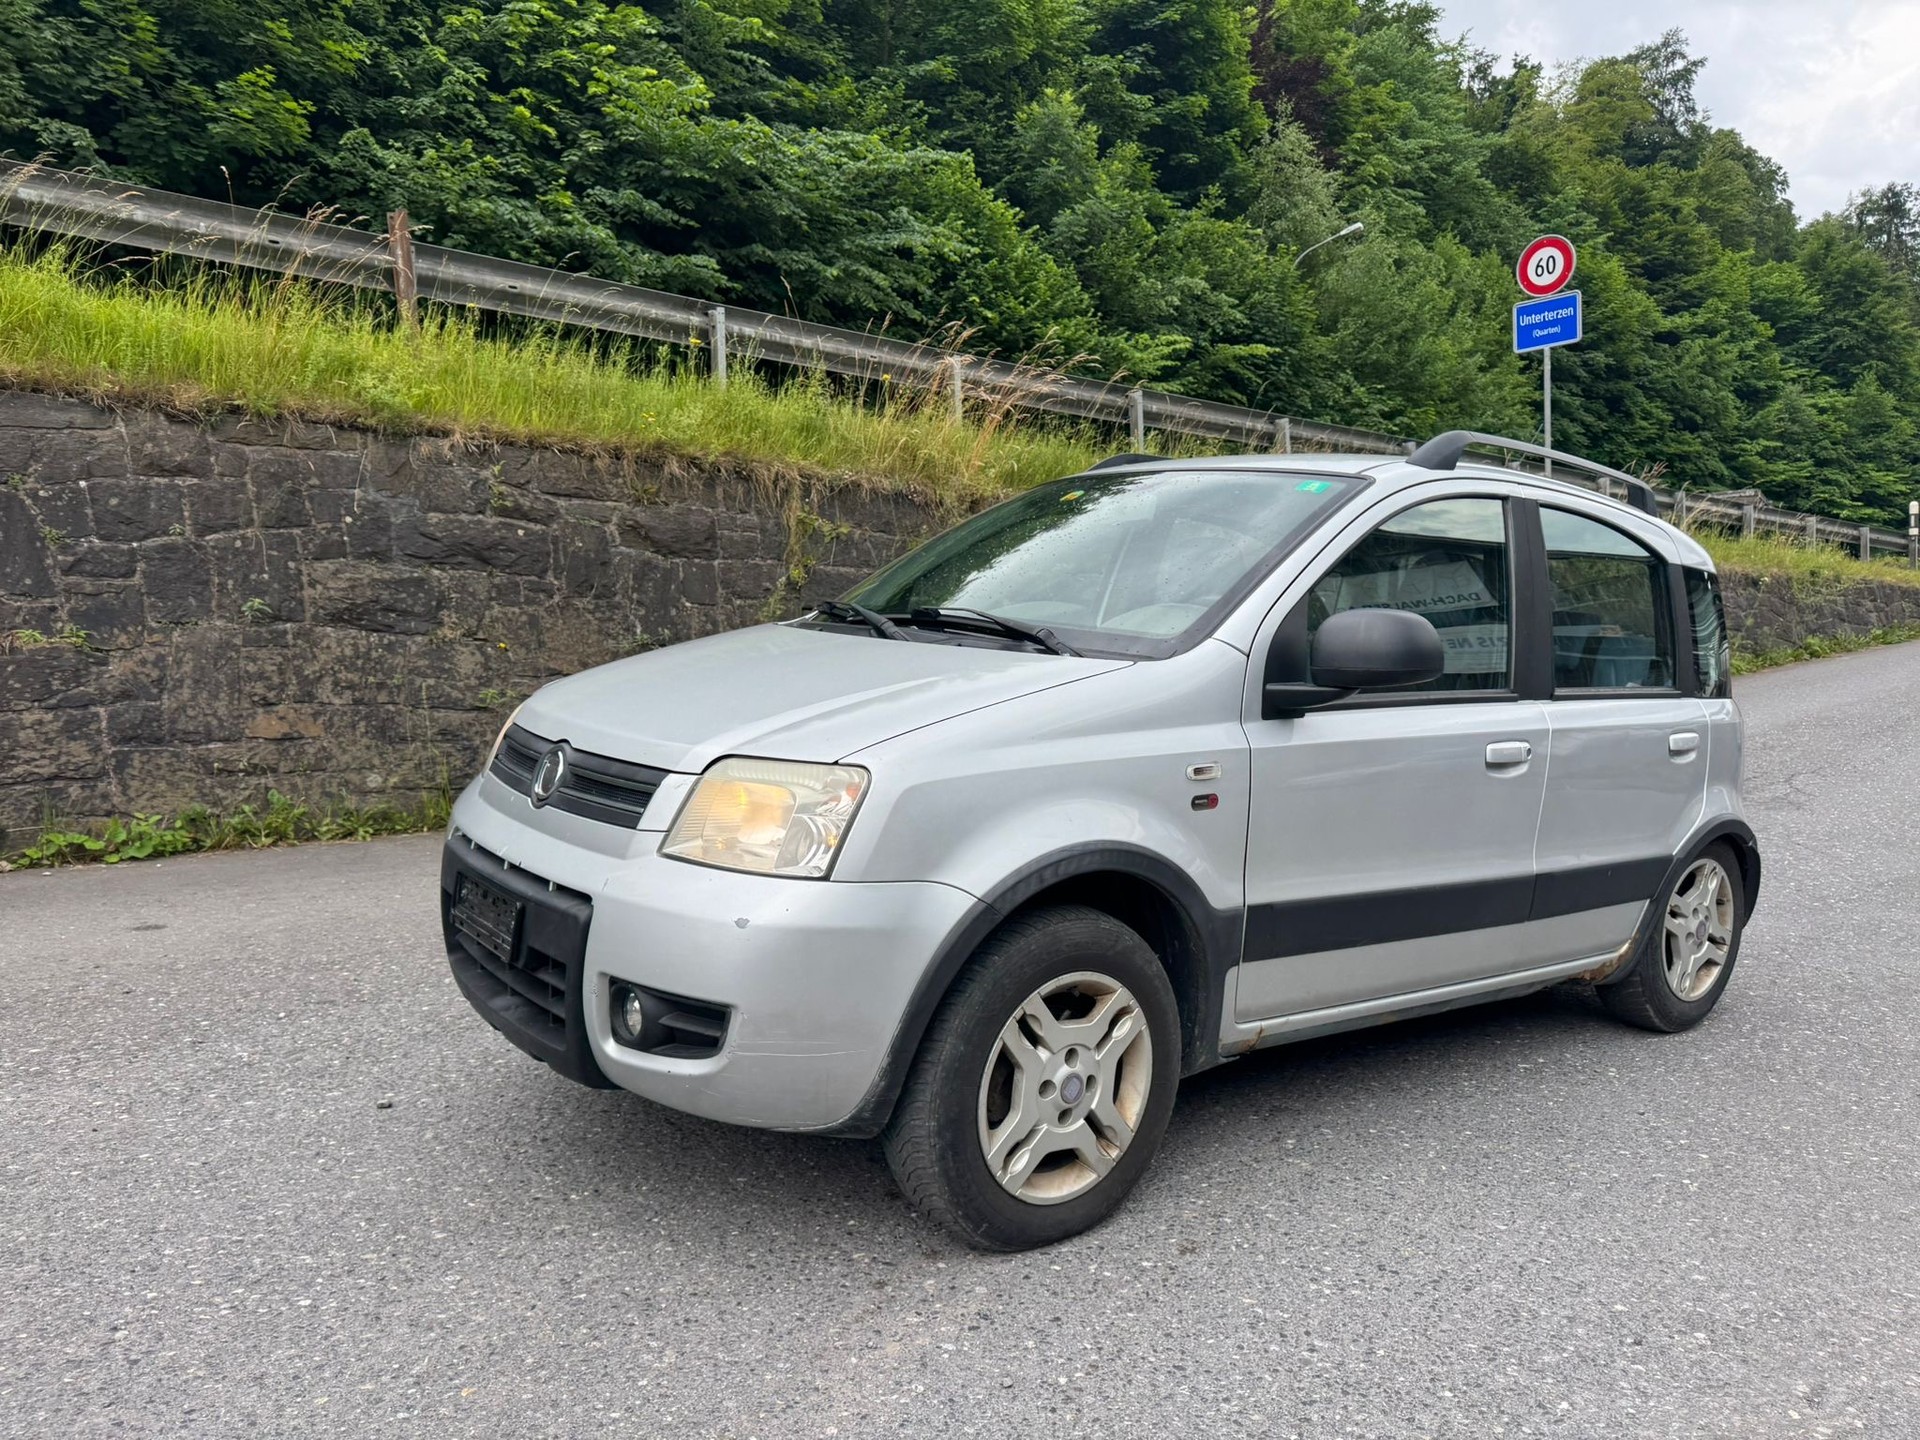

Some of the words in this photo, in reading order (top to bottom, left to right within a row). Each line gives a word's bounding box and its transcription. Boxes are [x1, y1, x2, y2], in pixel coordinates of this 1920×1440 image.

[1535, 255, 1556, 277] 60
[1520, 307, 1574, 326] Unterterzen
[1532, 325, 1561, 338] (Quarten)
